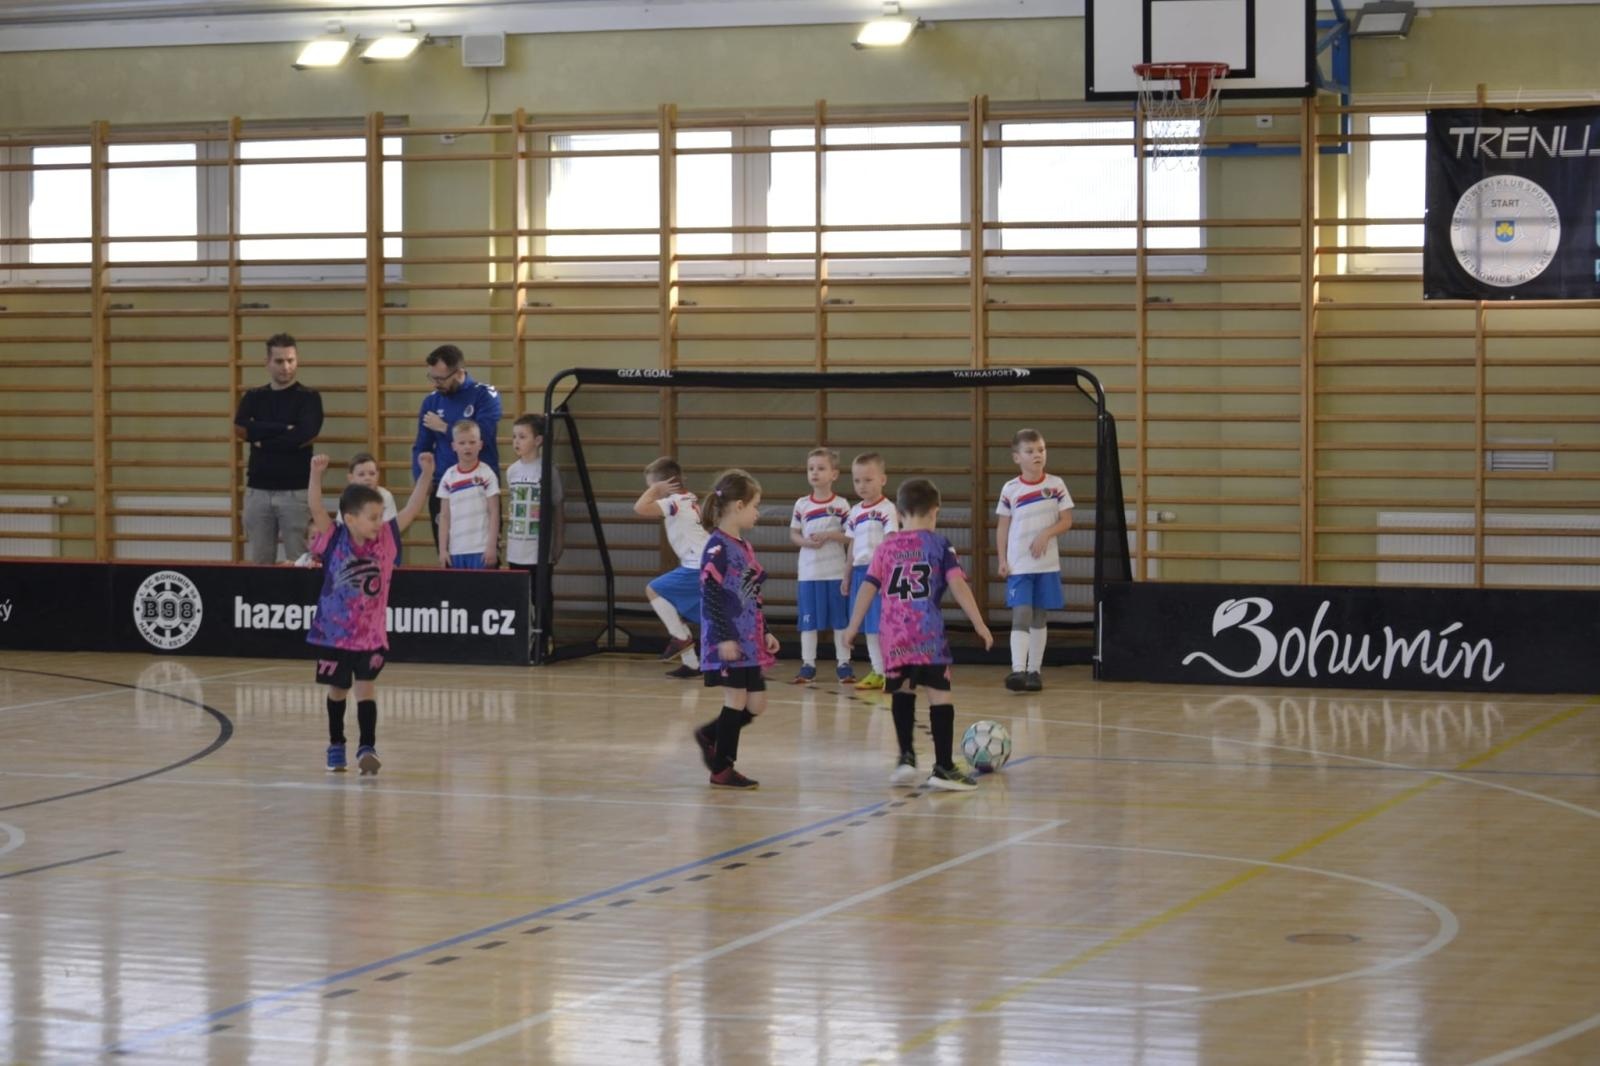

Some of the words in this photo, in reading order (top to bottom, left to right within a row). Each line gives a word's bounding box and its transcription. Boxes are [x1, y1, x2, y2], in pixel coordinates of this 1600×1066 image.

[1491, 200, 1520, 208] START
[617, 368, 640, 378] GIZA
[643, 368, 673, 378] GOAL
[952, 369, 1013, 378] YAKIMASPORT
[886, 563, 932, 600] 43
[141, 599, 195, 622] B98
[1182, 597, 1504, 682] Bohumín
[318, 660, 338, 676] 77
